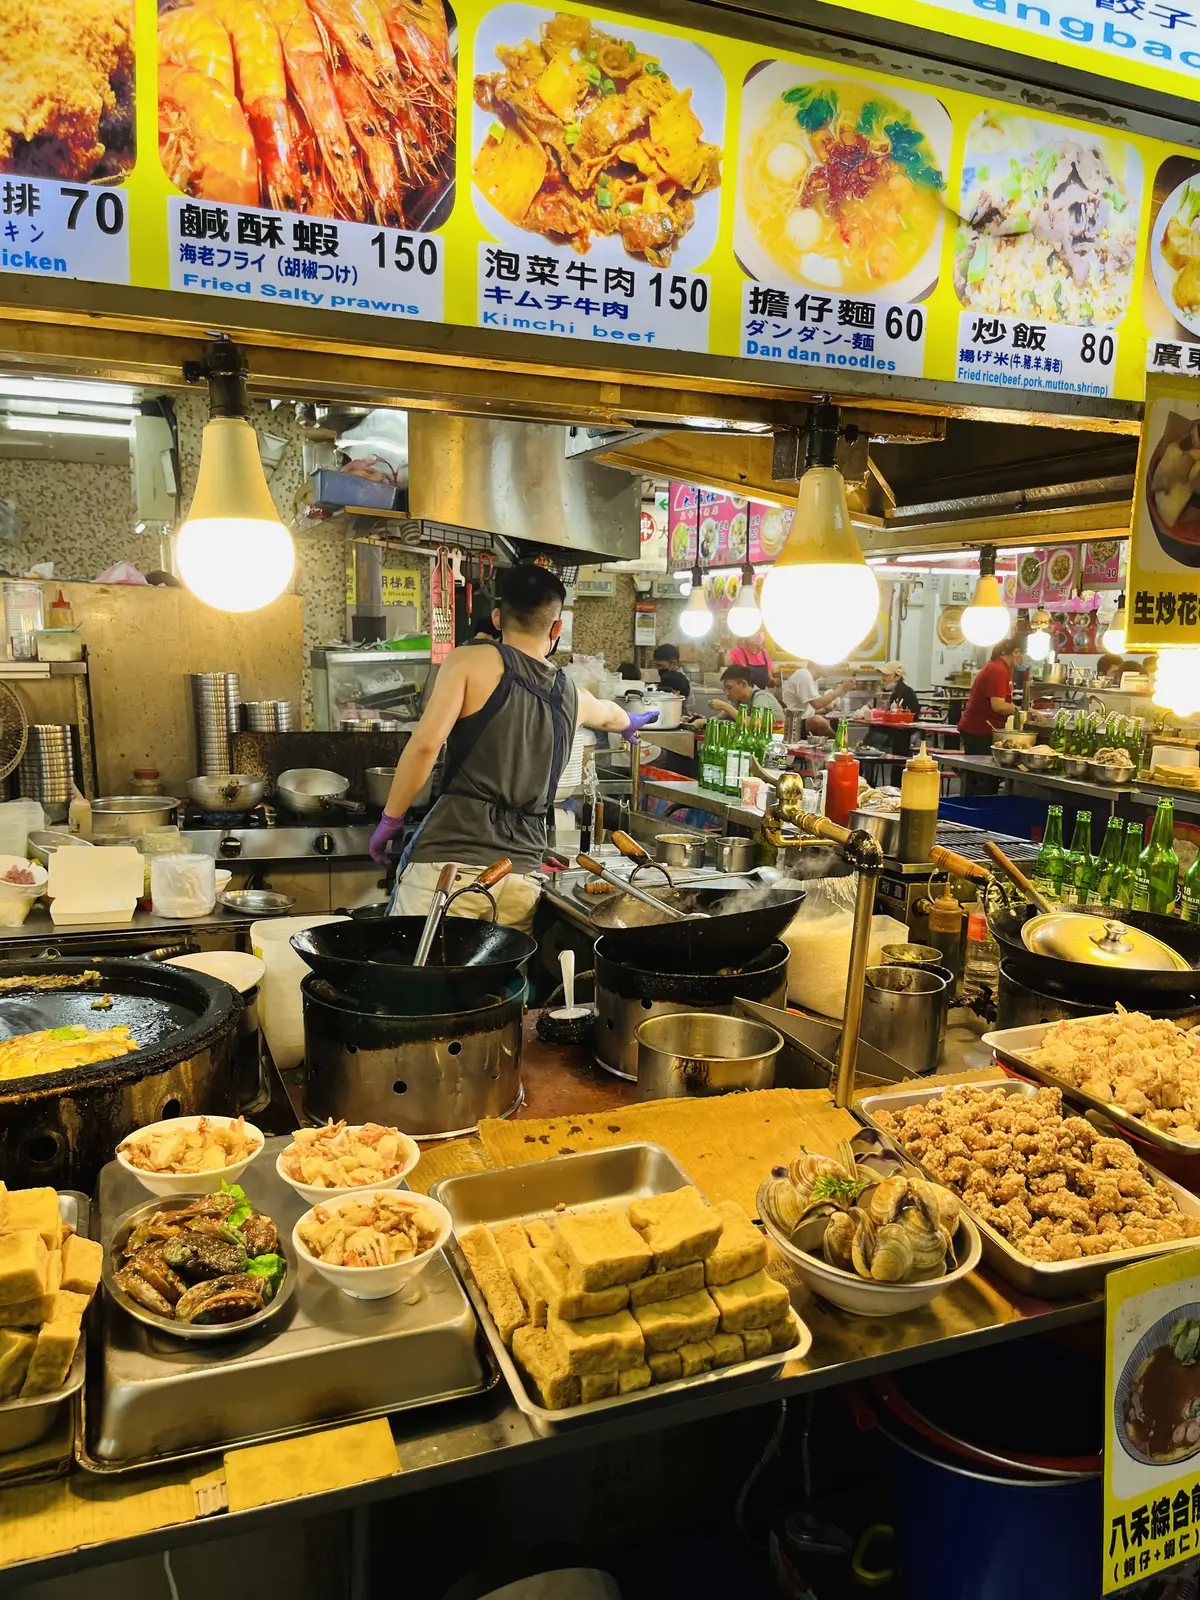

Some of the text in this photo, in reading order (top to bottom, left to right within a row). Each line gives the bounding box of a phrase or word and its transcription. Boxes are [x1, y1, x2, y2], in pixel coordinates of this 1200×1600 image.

[2, 182, 124, 235] 排 70
[179, 203, 438, 275] 鹹酥蝦 150
[183, 273, 420, 315] Fried Salty prawns
[485, 248, 708, 313] 泡菜牛肉 150
[484, 286, 629, 320] キムチ牛肉
[748, 286, 924, 342] 擔仔麵 60
[483, 311, 656, 343] Kimchi beef
[971, 317, 1114, 366] 炒飯 80
[747, 339, 896, 371] Dan dan noodles
[957, 367, 981, 381] Fried
[1105, 567, 1118, 579] 40
[1133, 591, 1200, 626] 生炒花
[1183, 885, 1192, 896] 18
